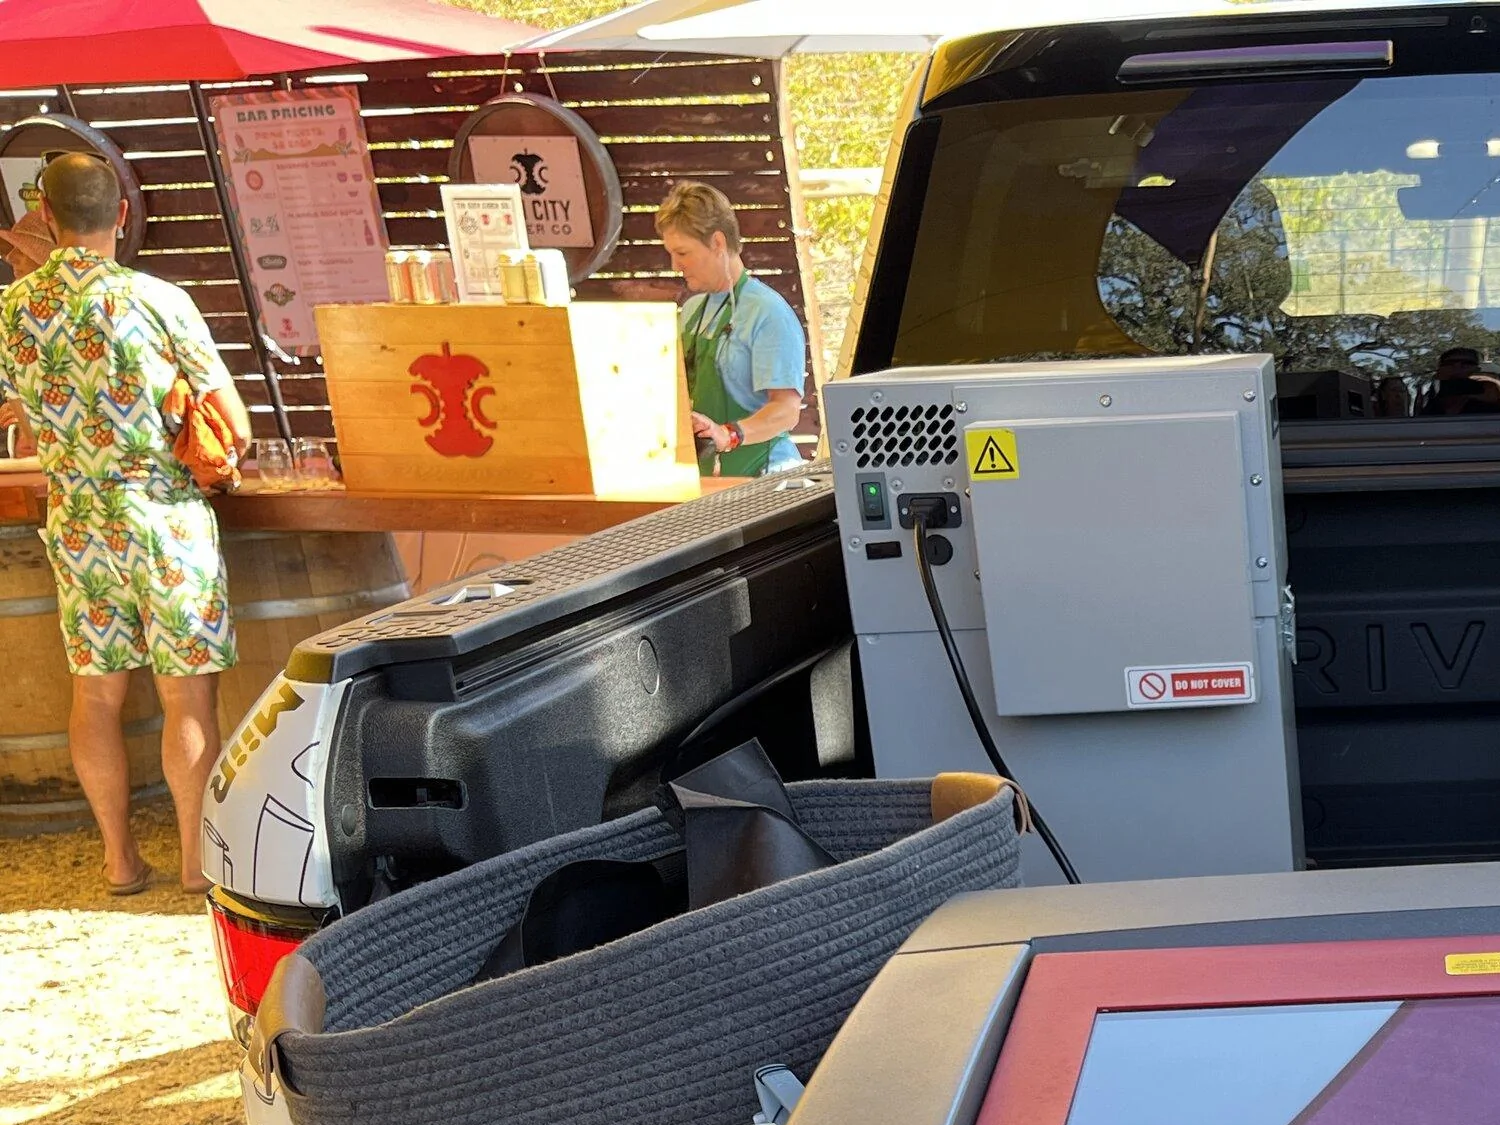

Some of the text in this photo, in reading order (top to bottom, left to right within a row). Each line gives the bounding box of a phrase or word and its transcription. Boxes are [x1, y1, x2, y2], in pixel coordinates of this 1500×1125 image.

[237, 104, 336, 122] BAR PRICING
[532, 200, 571, 221] CITY
[551, 223, 572, 235] CO
[1175, 677, 1241, 690] DO NOT COVER
